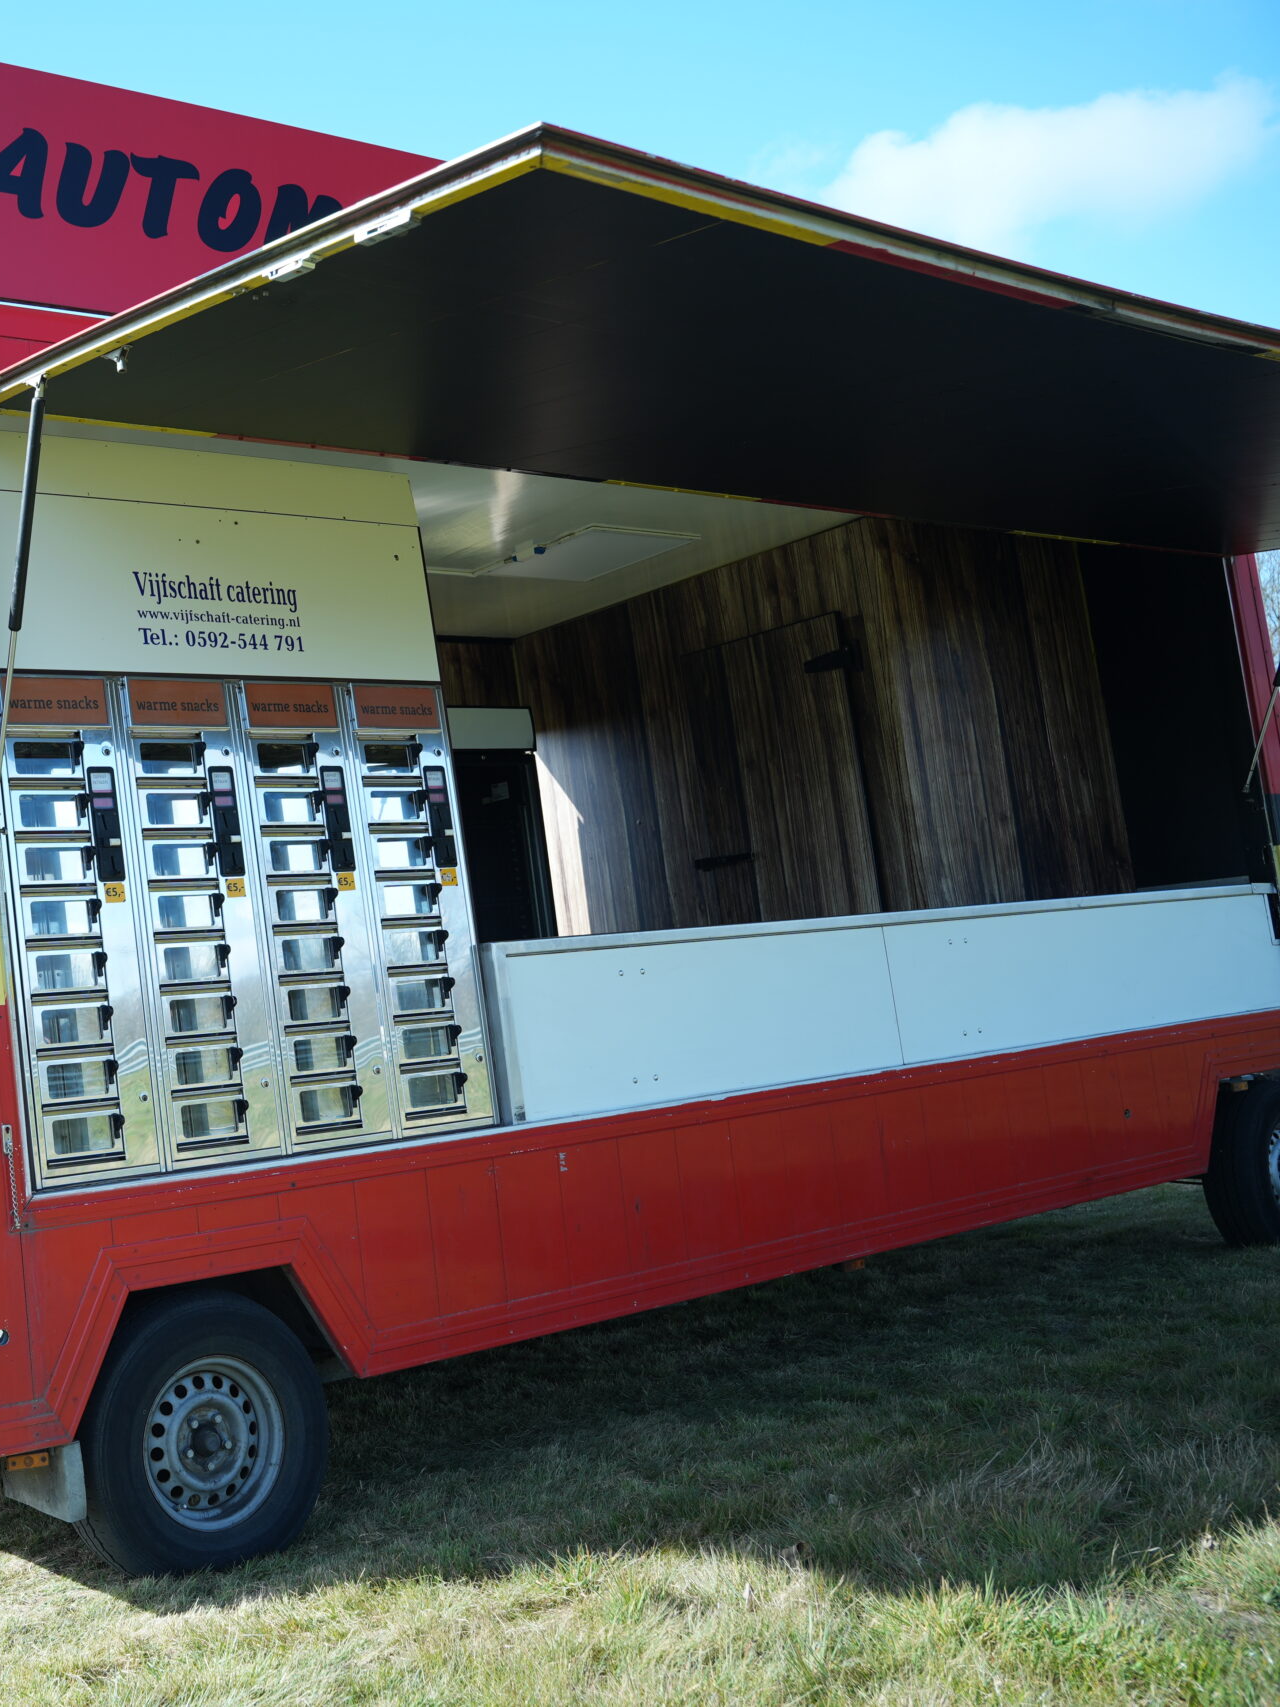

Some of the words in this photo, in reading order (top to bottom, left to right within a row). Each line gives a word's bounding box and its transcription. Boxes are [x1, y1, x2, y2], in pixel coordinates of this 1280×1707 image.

[132, 571, 223, 605] Vijfschaft
[226, 581, 298, 613] catering
[137, 609, 301, 629] www.vijfschaft-catering.nl
[138, 627, 179, 646] Tel.:
[185, 630, 269, 651] 0592-544
[274, 635, 305, 652] 791
[10, 699, 53, 710] warme
[56, 696, 100, 710] snacks
[136, 701, 178, 711] warme
[181, 699, 220, 712] snacks
[251, 702, 291, 713] warme
[293, 701, 329, 713] snacks
[360, 704, 397, 715] warme
[399, 704, 433, 716] snacks
[227, 882, 245, 893] €5,-
[338, 877, 355, 888] €5,-
[105, 887, 125, 898] €5,-
